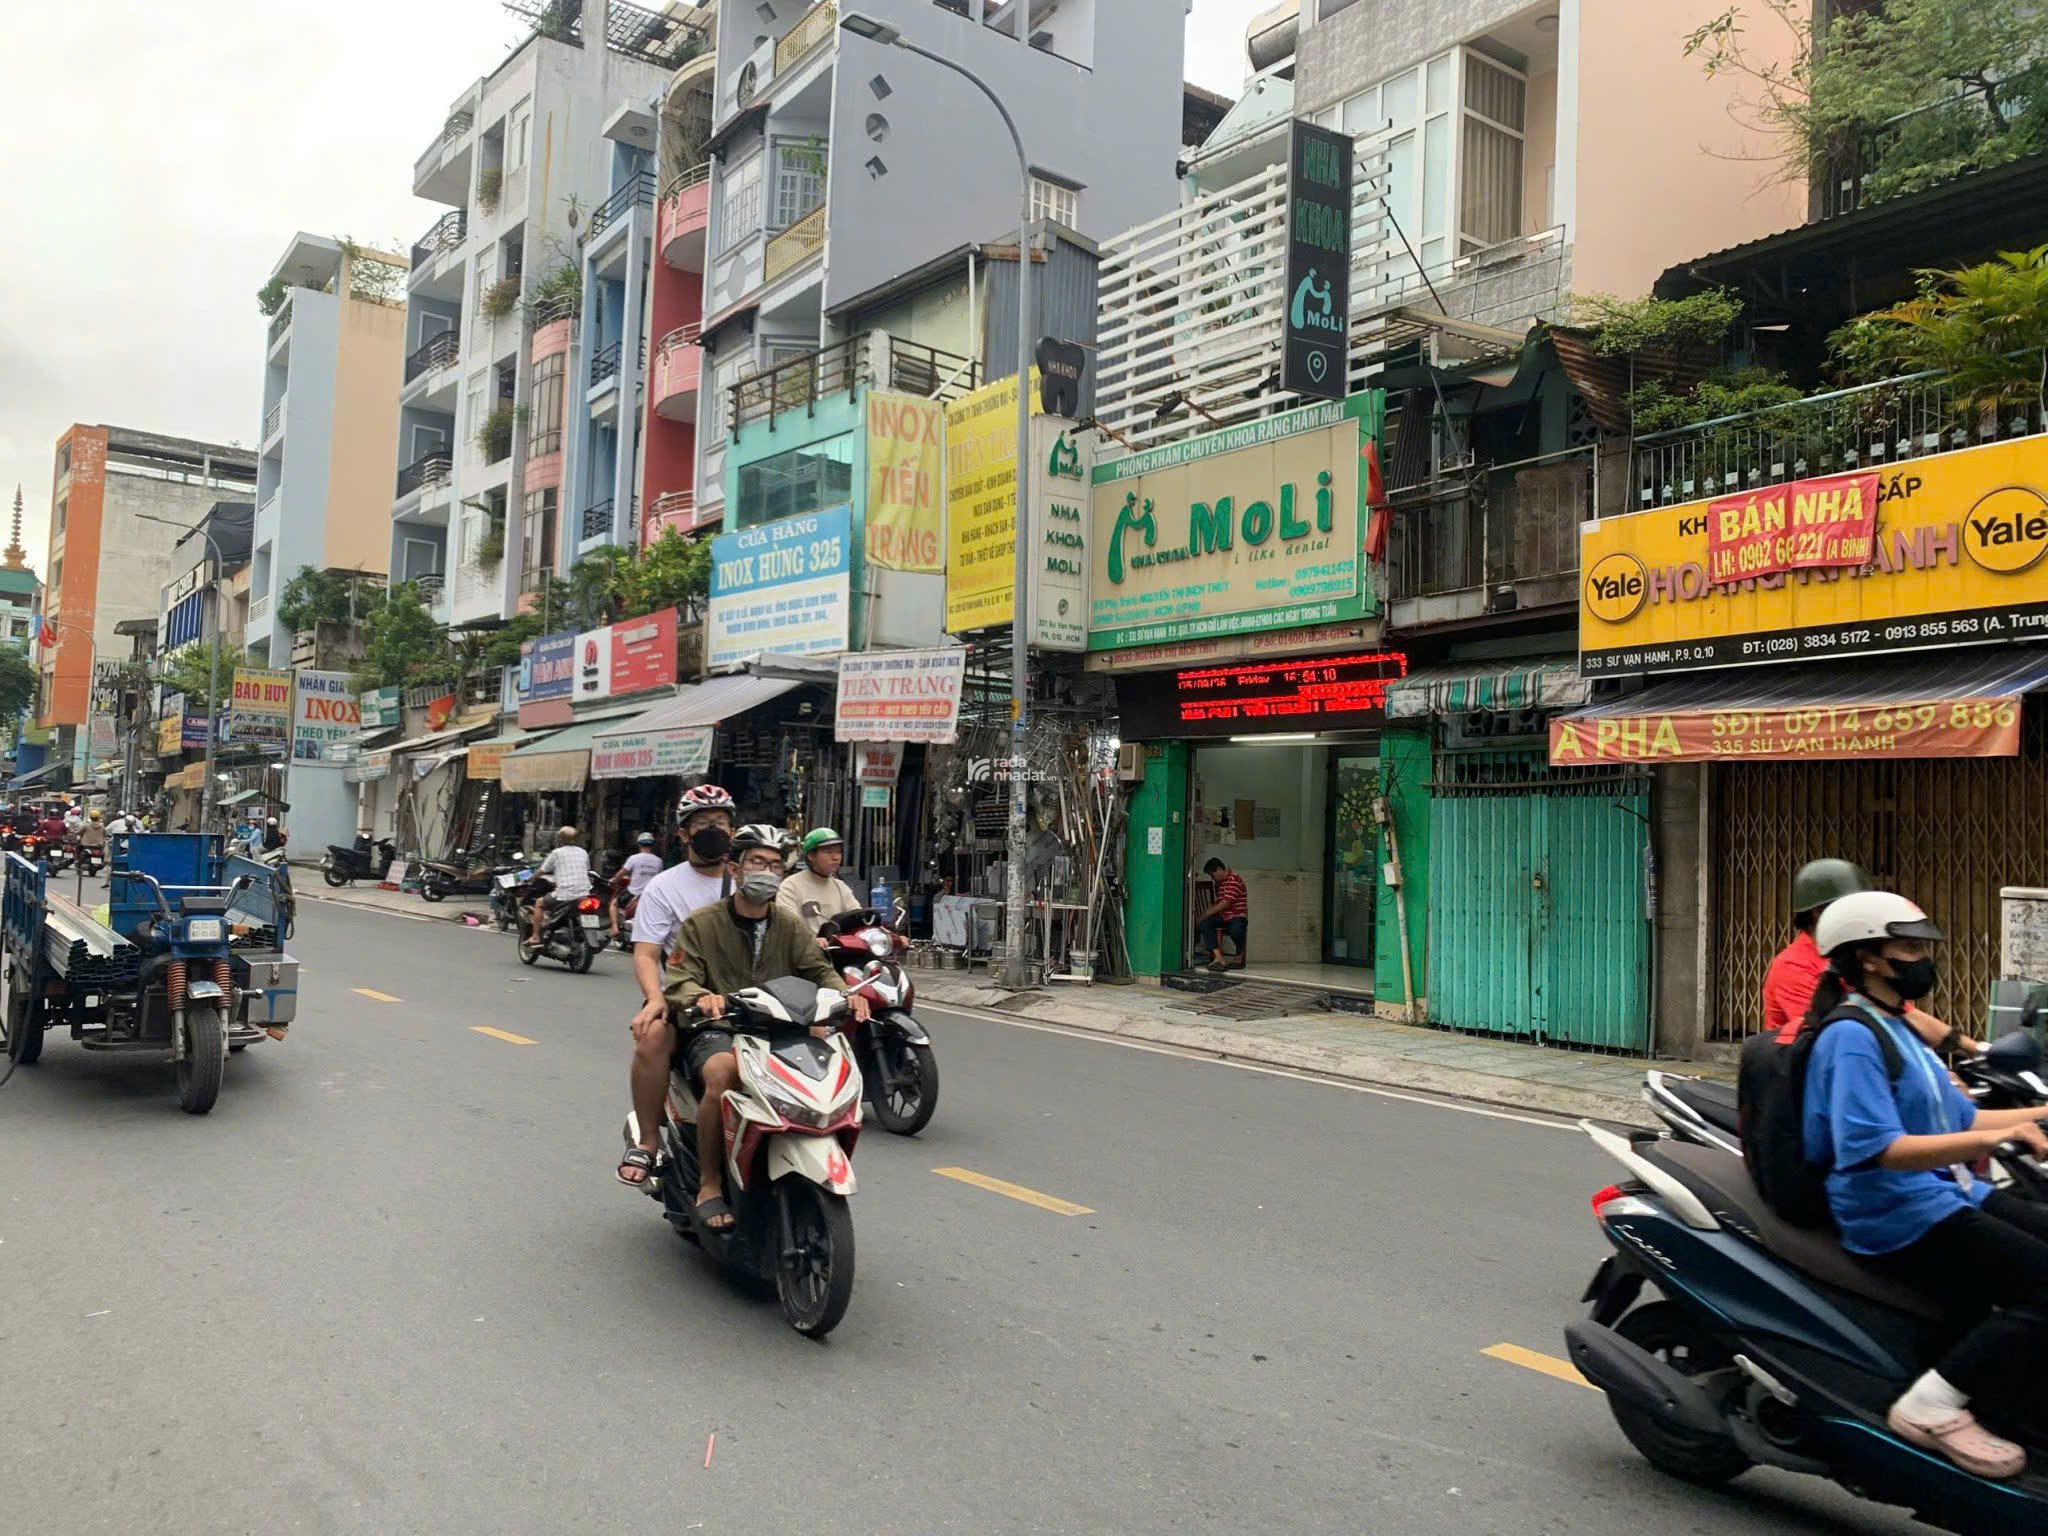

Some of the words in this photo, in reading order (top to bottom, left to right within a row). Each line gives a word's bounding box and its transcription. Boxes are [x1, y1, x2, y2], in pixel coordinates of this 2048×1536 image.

[1303, 135, 1340, 189] NHA
[1295, 198, 1344, 253] KHOA
[1306, 309, 1343, 332] MoLi
[871, 402, 938, 446] INOX
[1227, 428, 1256, 448] KHOA
[879, 454, 929, 508] TIẾN
[1050, 503, 1080, 521] NHA
[1189, 470, 1334, 557] MoLi
[1719, 496, 1786, 543] BÁN
[1793, 479, 1864, 526] NHÀ
[772, 518, 818, 541] HÀNG
[1045, 529, 1084, 550] KHOA
[1971, 513, 2048, 548] Yale
[866, 523, 938, 567] TRANG
[1285, 538, 1330, 556] dental
[1714, 549, 1736, 578] LH:
[1738, 540, 1772, 572] 0902
[1796, 532, 1824, 561] 221
[718, 556, 754, 590] INOX
[758, 544, 804, 582] HÙNG
[810, 536, 841, 572] 325
[1046, 557, 1081, 576] MOLI
[1591, 572, 1642, 601] Yale
[1586, 657, 1603, 670] 333
[1606, 654, 1620, 668] SƯ
[1623, 652, 1642, 668] VẠN
[1694, 646, 1714, 661] Q.10
[1804, 634, 1837, 648] 3834
[1840, 630, 1870, 646] 5172
[1885, 625, 1917, 641] 0913
[1920, 622, 1947, 636] 855
[1952, 618, 1978, 634] 563
[95, 662, 120, 678] GYM
[93, 688, 118, 704] YOGA
[234, 676, 260, 700] BẢO
[264, 684, 289, 702] HUY
[300, 675, 326, 694] NHẬN
[328, 680, 344, 694] GIA
[842, 671, 883, 697] TIẾN
[888, 674, 957, 696] TRANG
[304, 698, 361, 724] INOX
[296, 726, 323, 739] THEO
[1552, 720, 1584, 759] A
[1597, 716, 1682, 758] PHA
[1711, 712, 1772, 737] SĐT:
[1710, 740, 1744, 754] 335
[1750, 738, 1773, 754] SƯ
[1780, 736, 1824, 756] VẠN
[1832, 735, 1896, 754] HẠNH
